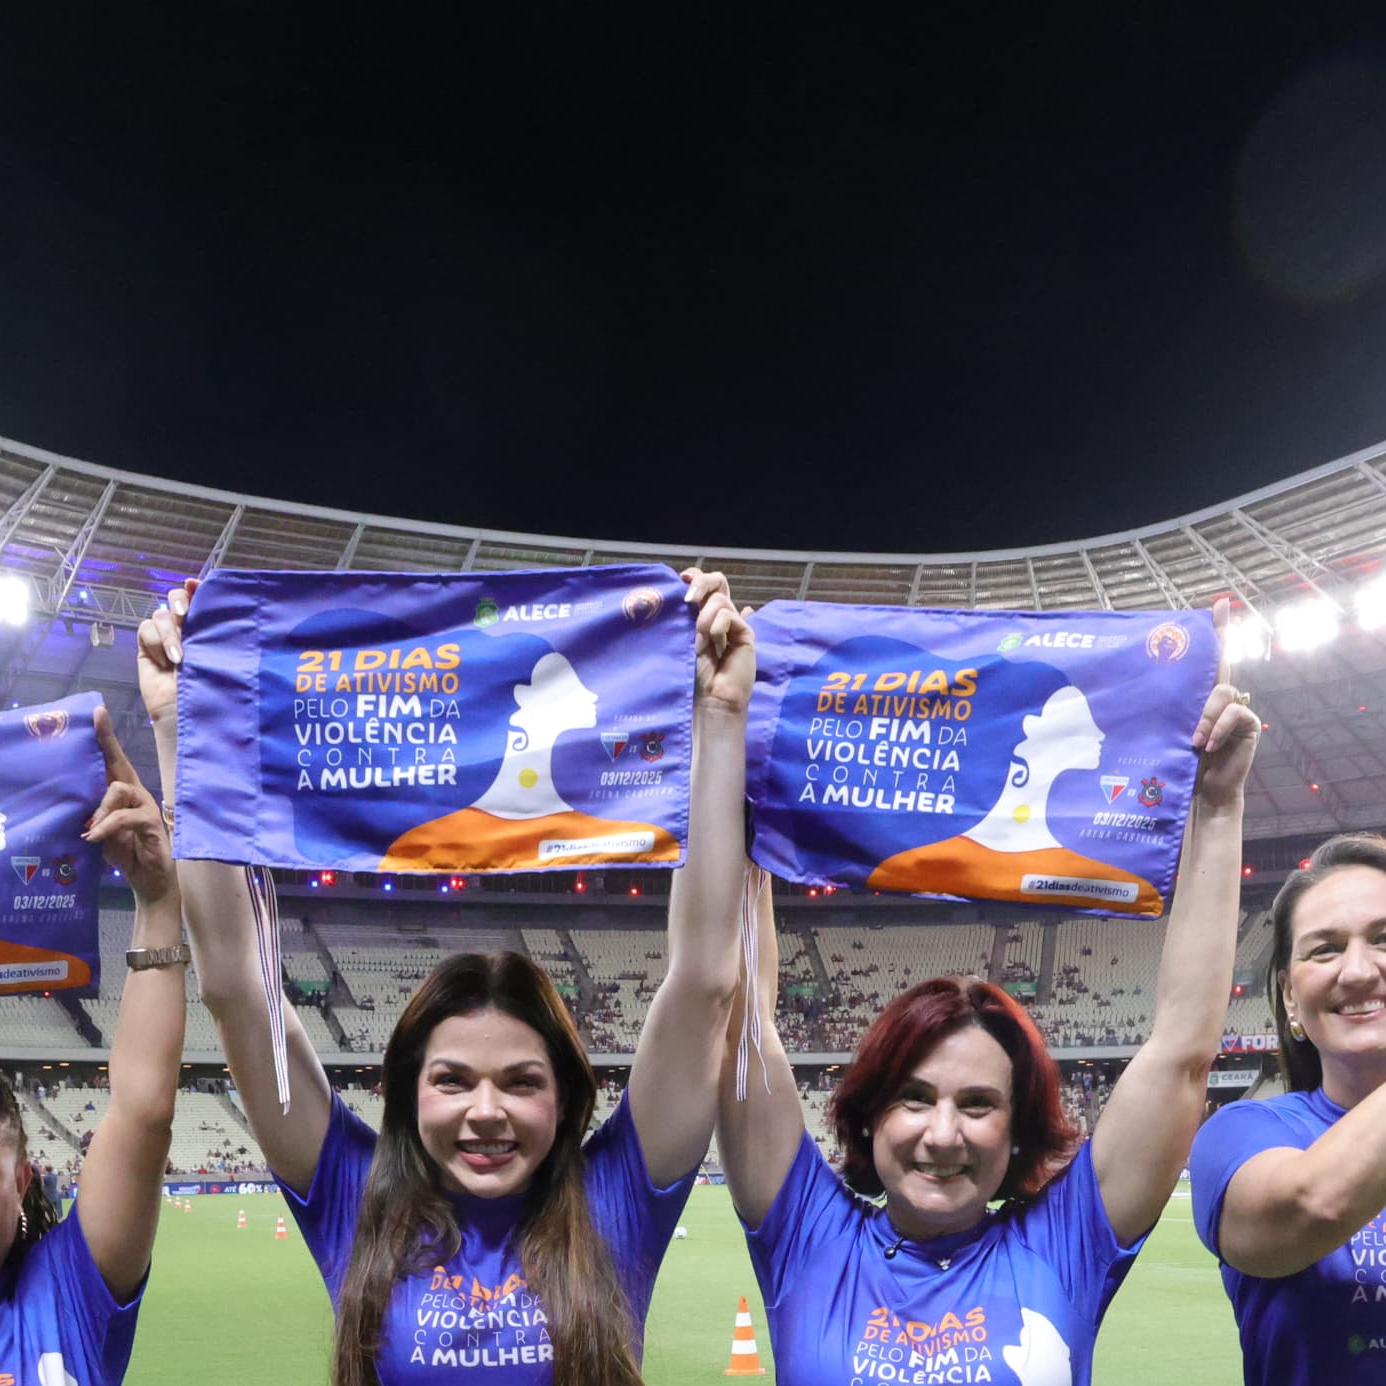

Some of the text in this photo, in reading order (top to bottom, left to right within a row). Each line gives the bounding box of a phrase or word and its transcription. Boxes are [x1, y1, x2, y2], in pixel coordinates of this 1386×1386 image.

[503, 604, 571, 622] ALECE
[1024, 632, 1095, 648] ALECE
[296, 644, 461, 672] 21 DIAS
[296, 672, 459, 694] DE ATIVISMO
[821, 669, 978, 696] 21 DIAS
[294, 694, 460, 719] PELO FIM DA
[817, 691, 971, 721] DE ATIVISMO
[295, 717, 457, 745] VIOLÊNCIA
[810, 717, 967, 746] PELO FIM DA
[297, 748, 455, 766] CONTRA
[807, 739, 959, 771] VIOLÊNCIA
[297, 764, 456, 791] A MULHER
[600, 770, 663, 785] 03/12/2025
[806, 764, 955, 792] CONTRA
[799, 782, 955, 814] A MULHER
[1093, 812, 1157, 830] 03/12/2025
[1029, 880, 1129, 897] #21diasdeativismo
[14, 895, 75, 910] 03/12/2025
[1222, 1072, 1254, 1081] CEARÁ
[224, 1184, 236, 1193] ATÉ
[239, 1182, 262, 1194] 60%
[421, 1293, 465, 1310] PELO
[1352, 1286, 1367, 1303] A
[414, 1330, 551, 1347] CONTRA
[864, 1326, 891, 1343] DE
[410, 1345, 554, 1367] A MULHER
[856, 1341, 992, 1372] PELO FIM DA
[853, 1356, 992, 1384] VIOLÊNCIA
